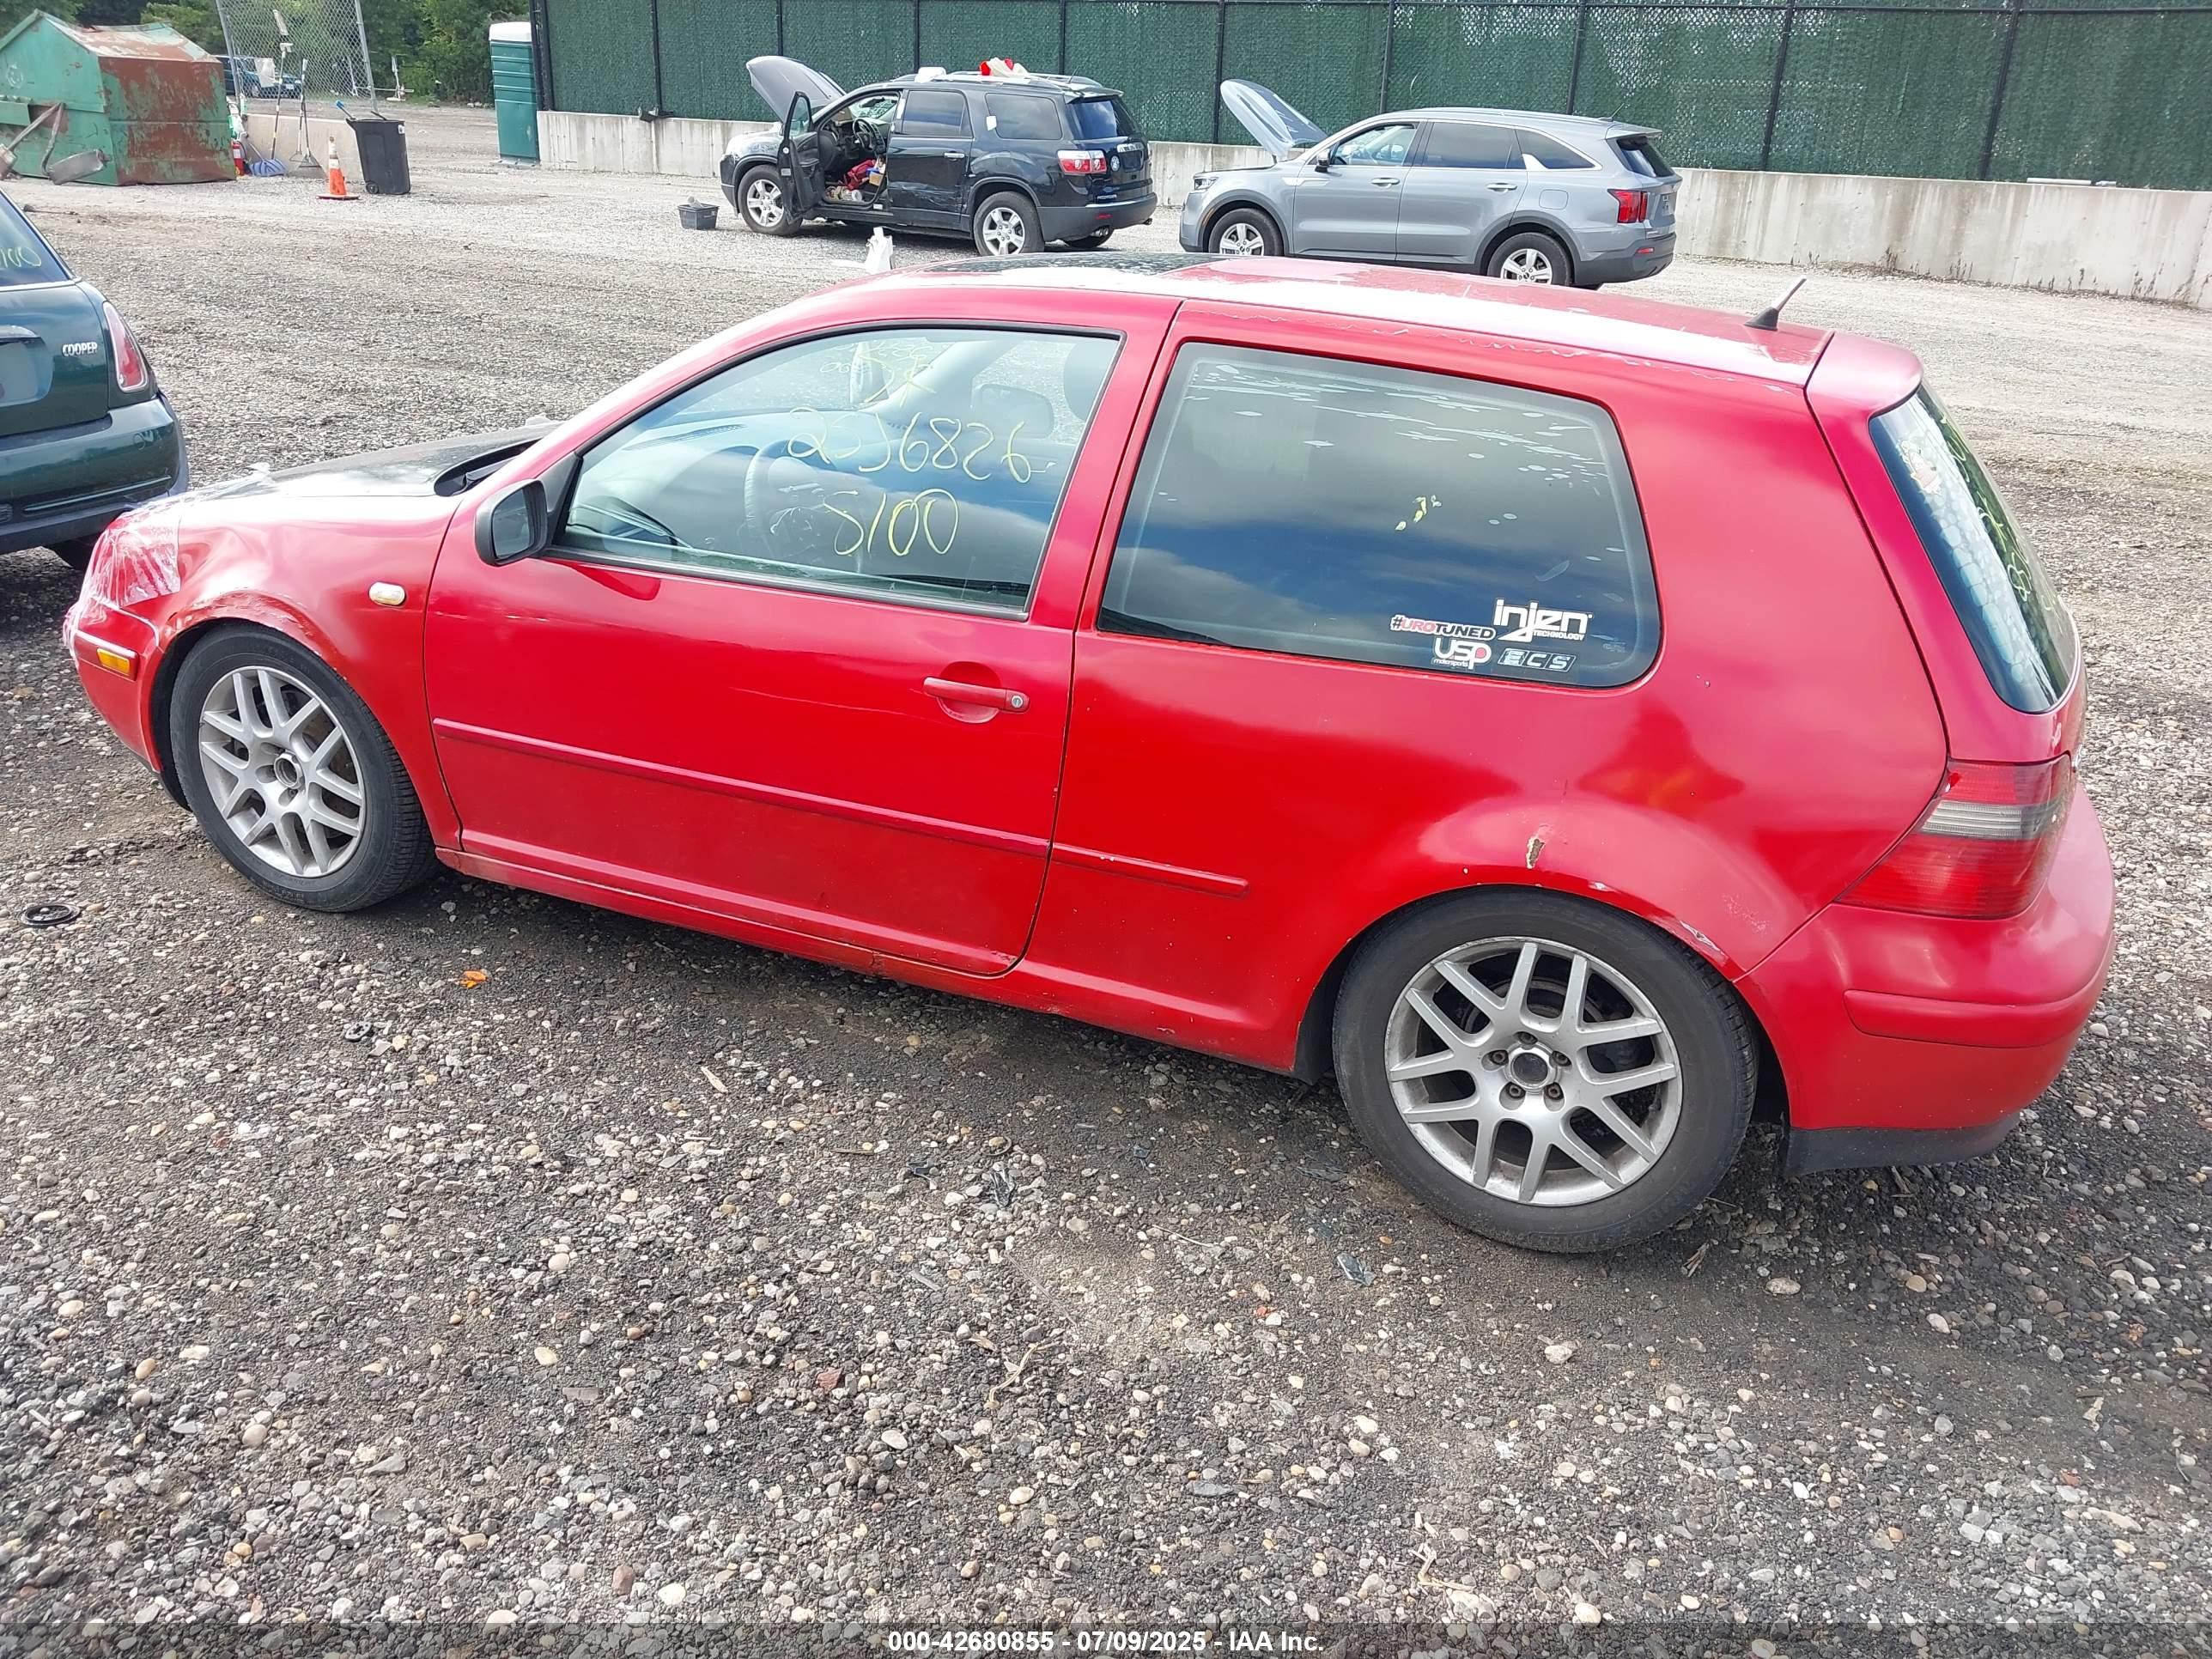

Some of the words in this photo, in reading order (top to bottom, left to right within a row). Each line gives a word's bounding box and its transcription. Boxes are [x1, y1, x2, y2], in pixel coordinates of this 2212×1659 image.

[62, 342, 98, 357] COOPER
[1392, 616, 1495, 640] #UROTUNED
[1533, 630, 1585, 641] TECHNOLOGY
[1433, 658, 1469, 668] motorsports
[1504, 650, 1571, 670] ECS
